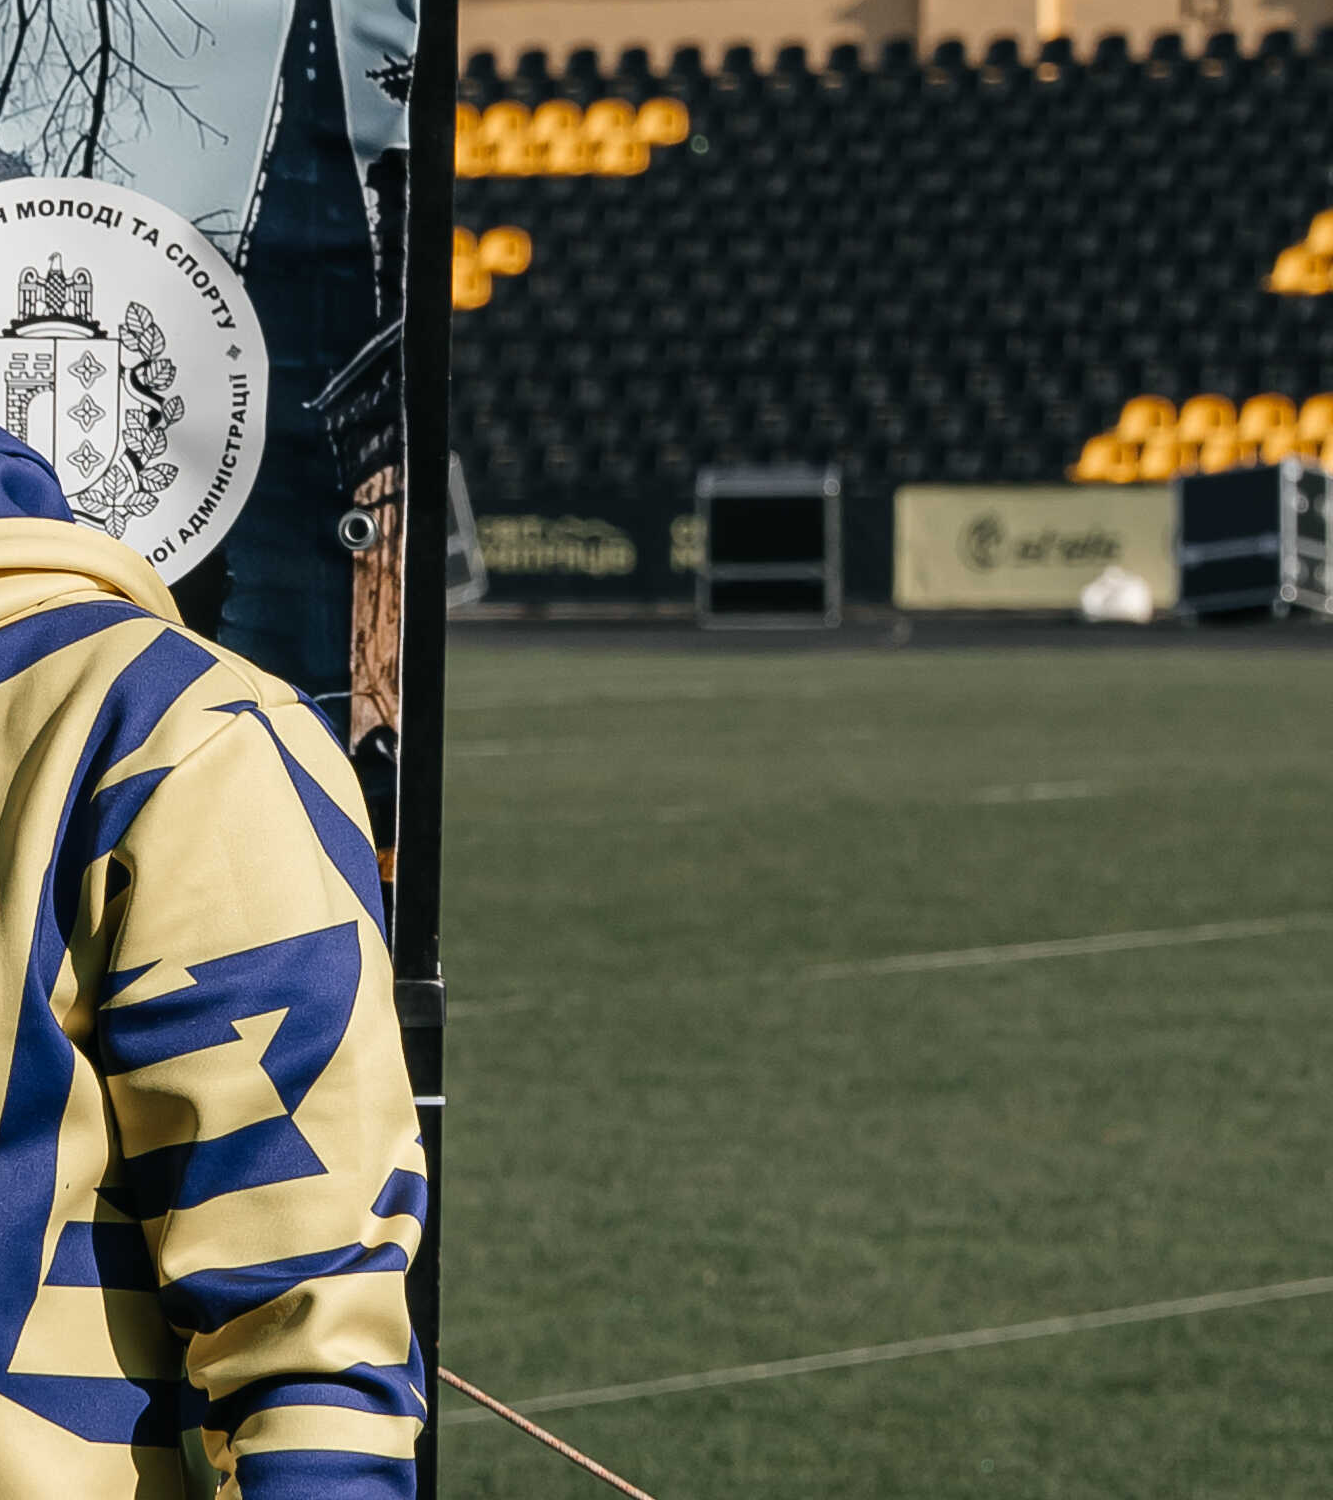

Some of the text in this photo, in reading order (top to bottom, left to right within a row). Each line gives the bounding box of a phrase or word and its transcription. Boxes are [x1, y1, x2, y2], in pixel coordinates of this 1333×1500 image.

[15, 199, 123, 229] МОЛОДІ
[132, 217, 160, 248] ТА
[165, 243, 237, 329] СПОРТУ
[177, 373, 251, 545] АДМІНІСТРАЦІЇ
